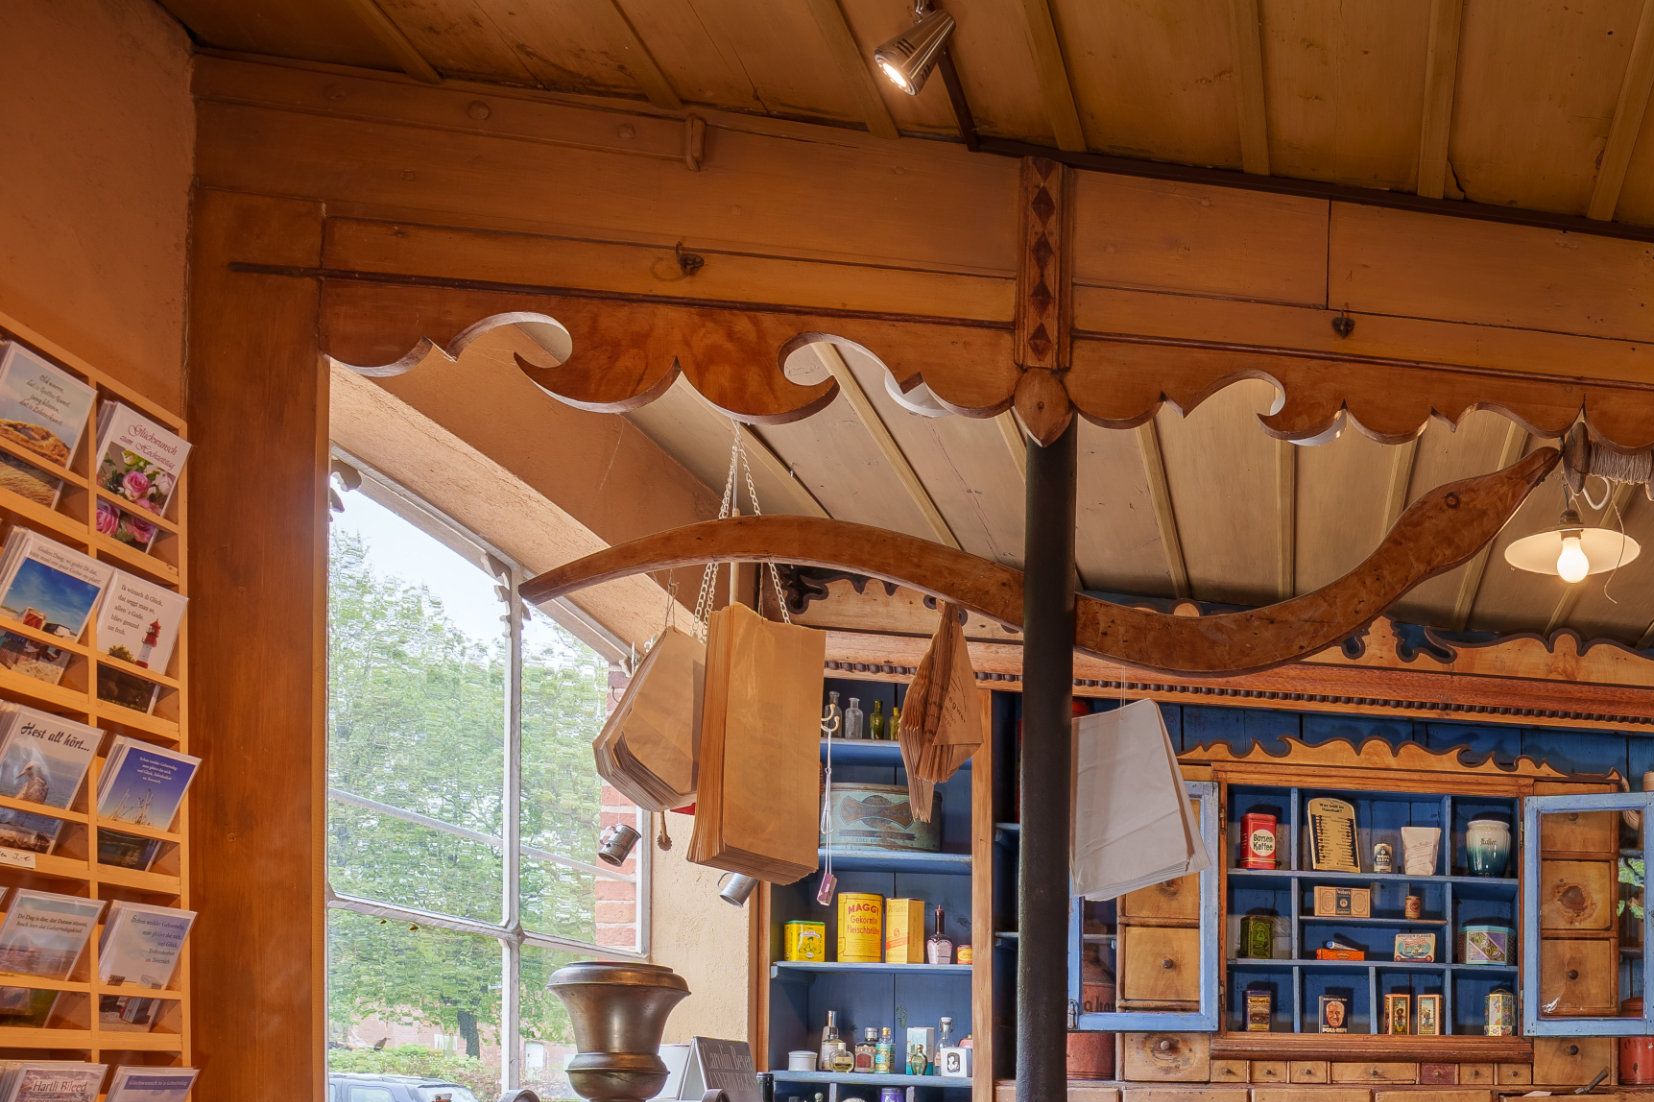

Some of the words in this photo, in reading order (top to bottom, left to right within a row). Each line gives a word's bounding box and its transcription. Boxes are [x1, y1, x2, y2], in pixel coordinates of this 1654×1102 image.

[48, 731, 62, 745] all
[1252, 842, 1275, 852] Kaffee
[848, 903, 879, 916] MAGGI
